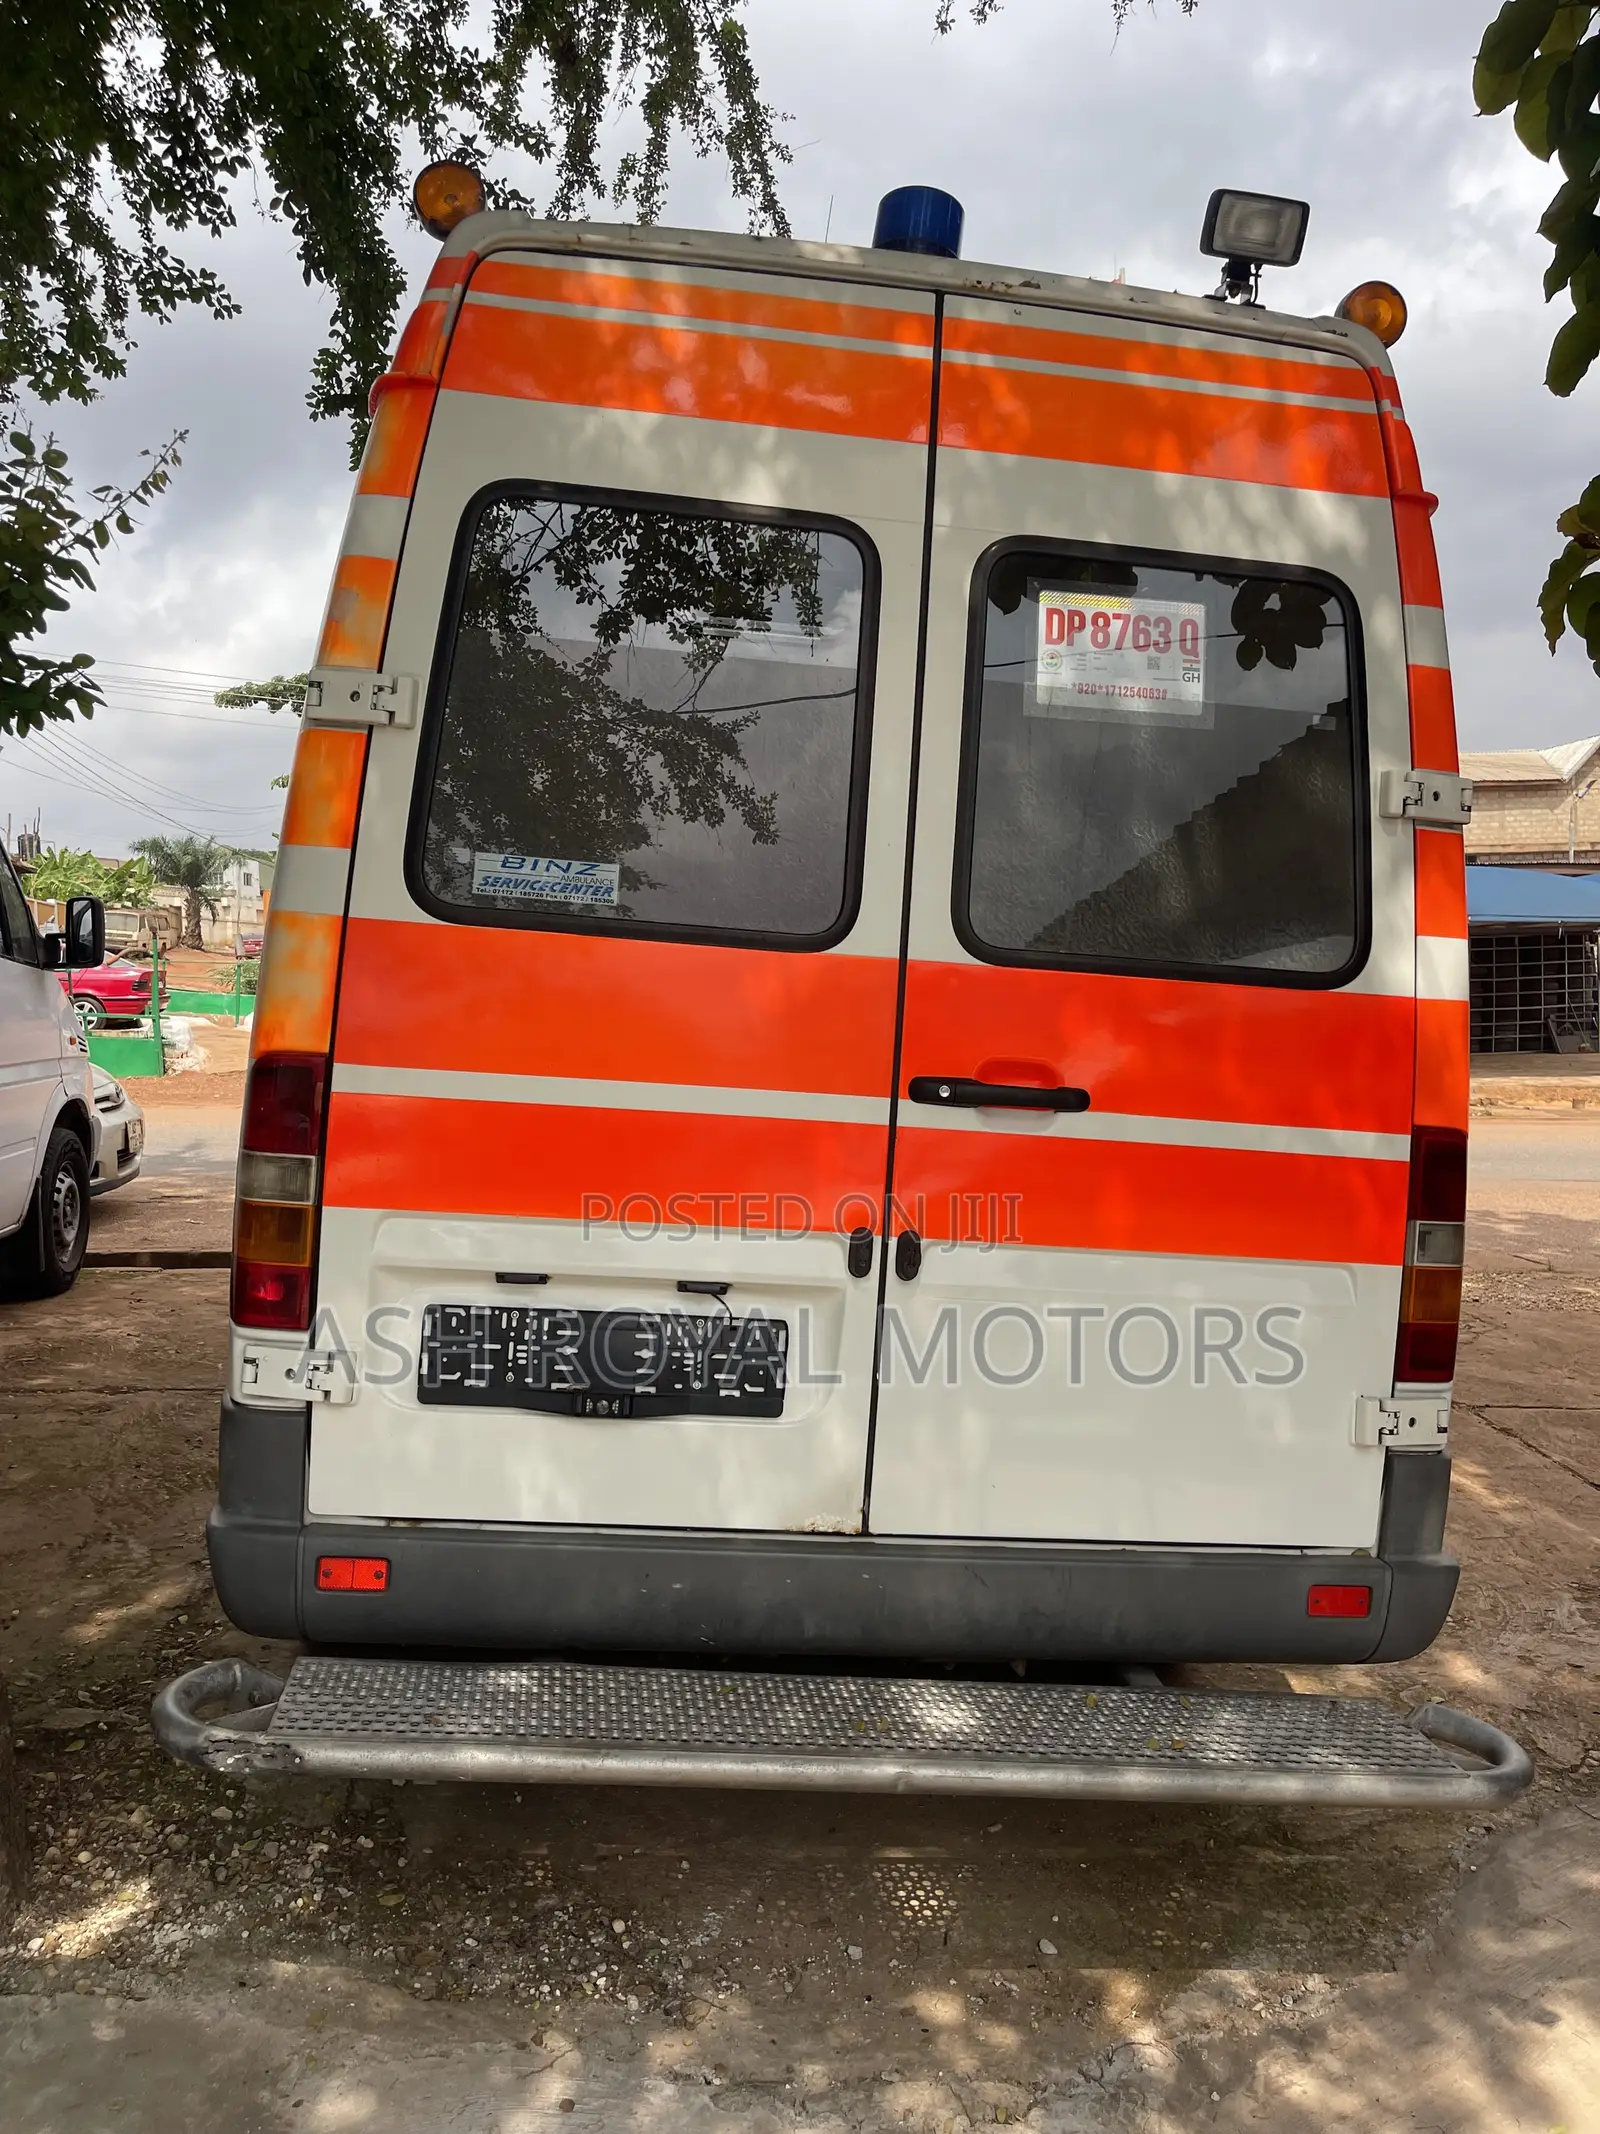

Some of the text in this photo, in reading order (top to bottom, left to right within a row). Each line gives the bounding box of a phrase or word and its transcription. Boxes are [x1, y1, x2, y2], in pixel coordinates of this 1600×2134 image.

[1045, 607, 1200, 658] DP 8763 Q
[1182, 672, 1201, 683] GH
[500, 855, 601, 877] BINZ
[478, 875, 614, 898] SERVICECENTER
[559, 874, 615, 887] AMBULANCE
